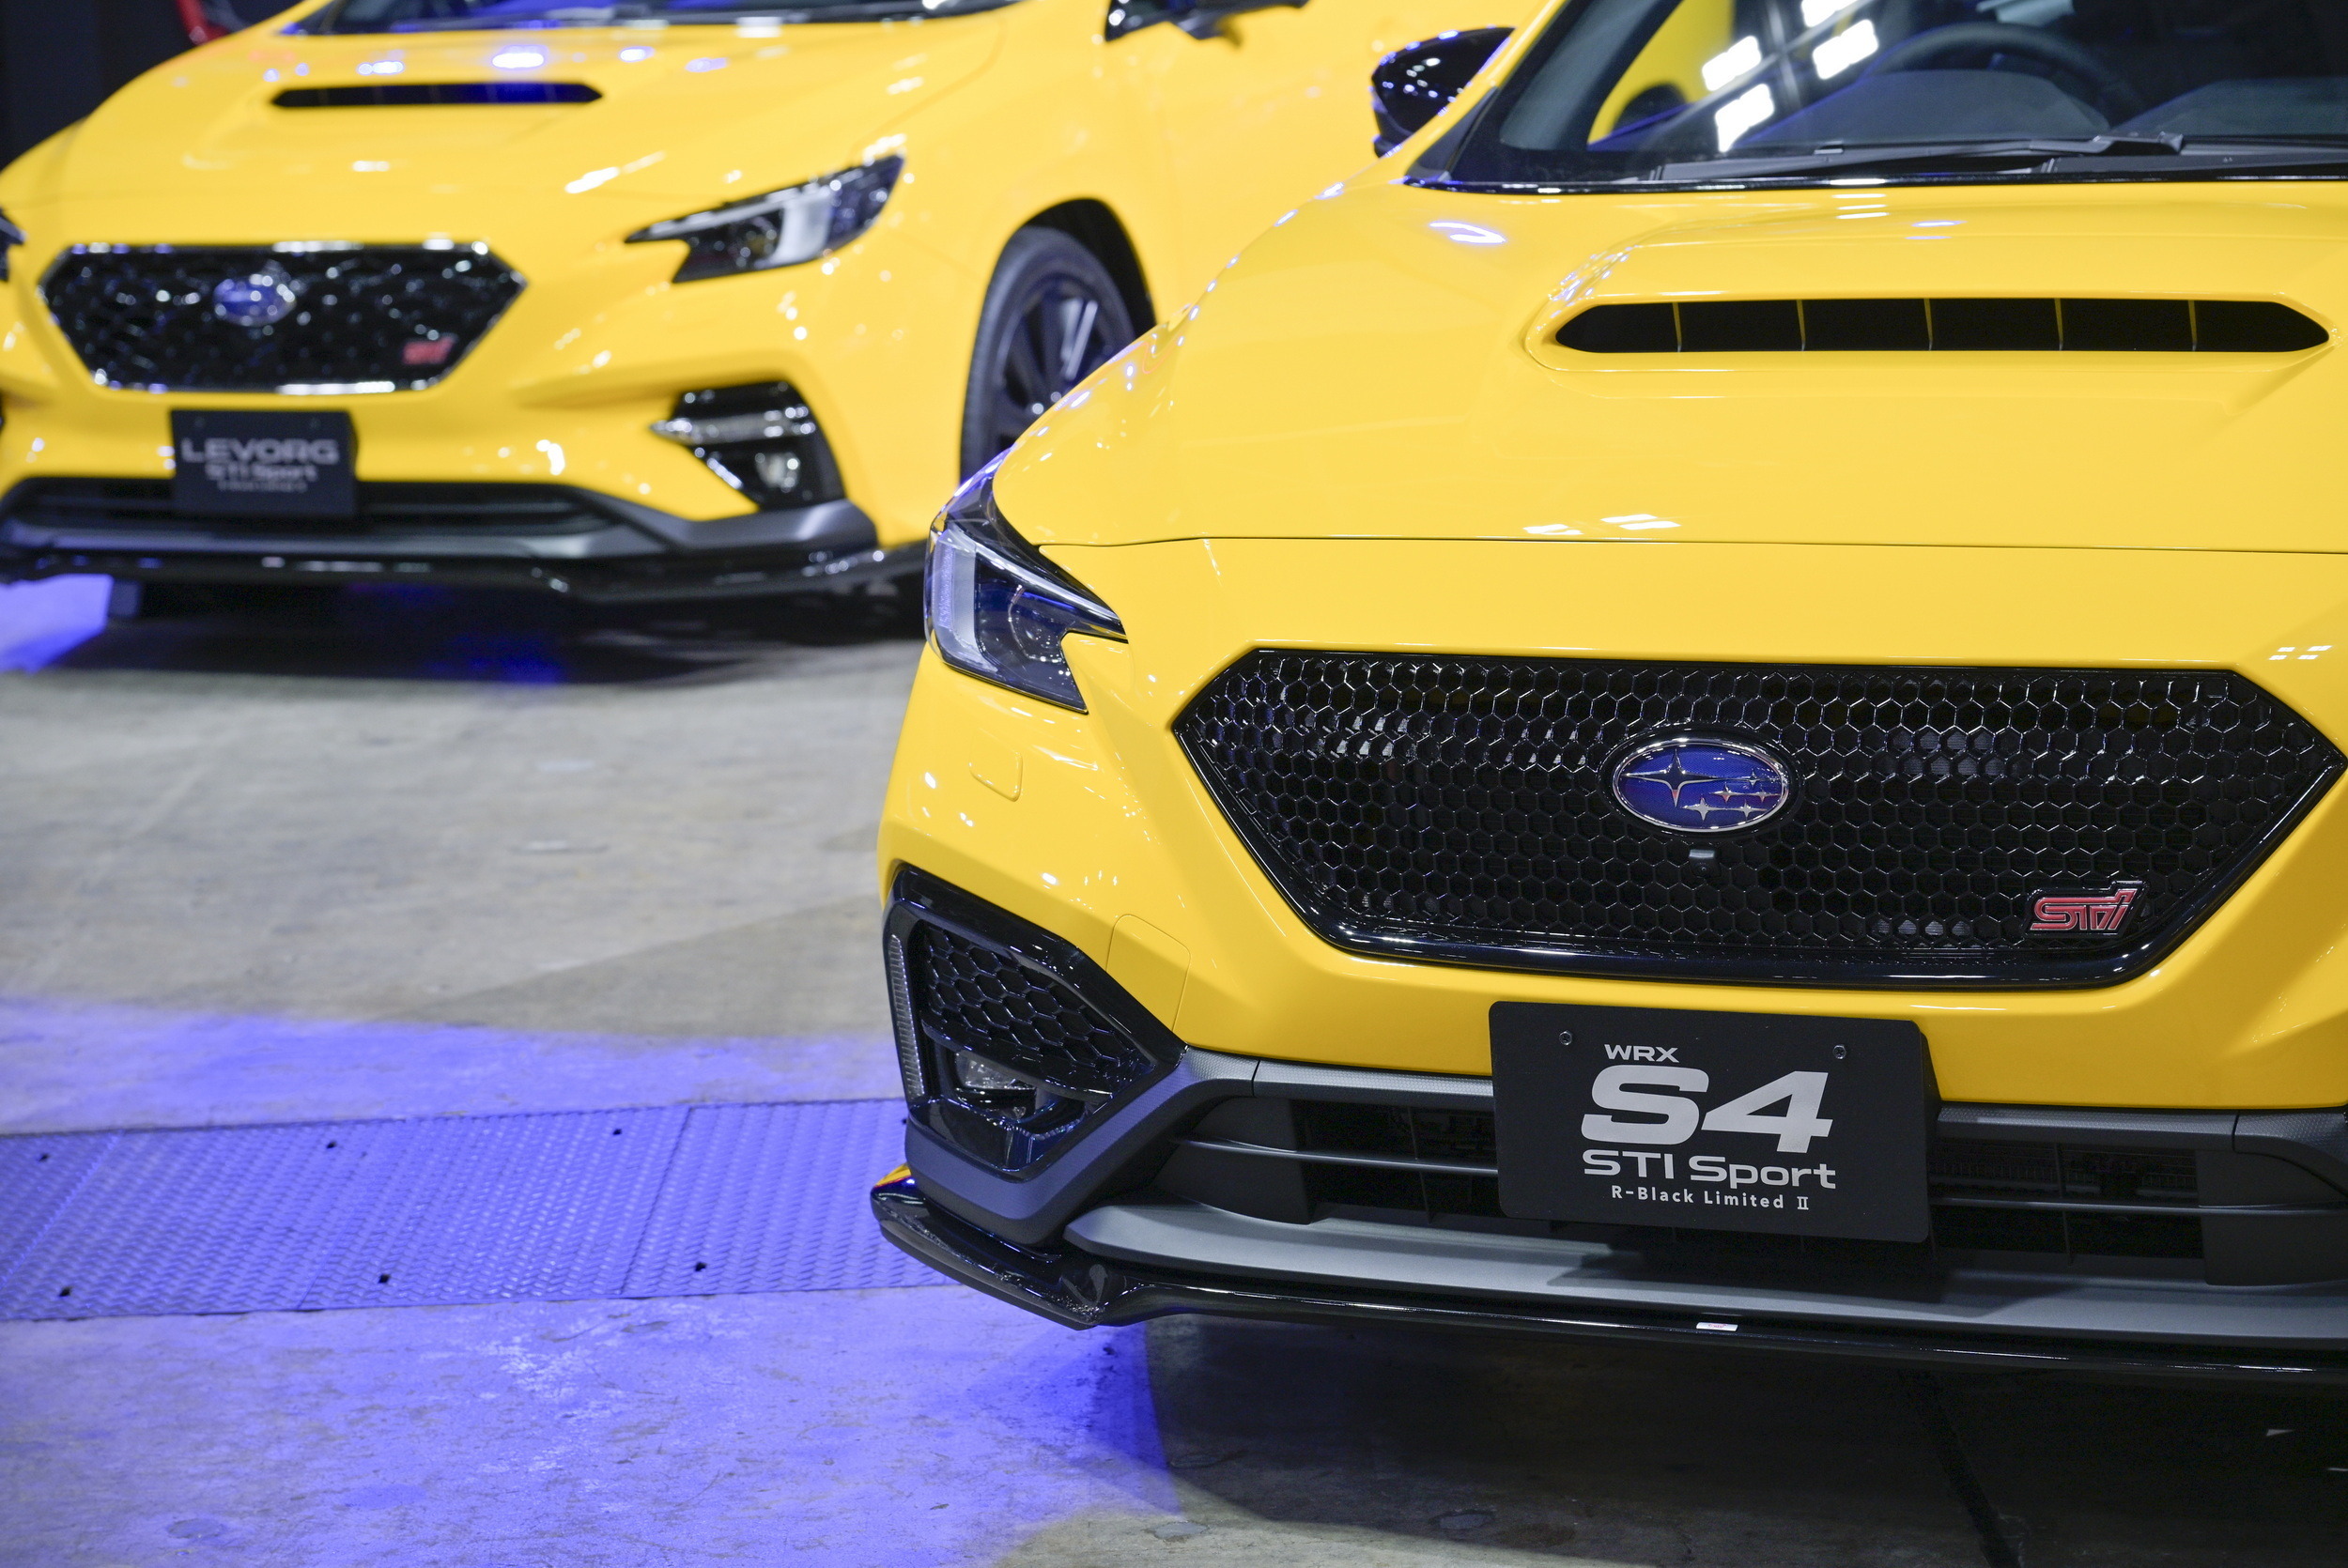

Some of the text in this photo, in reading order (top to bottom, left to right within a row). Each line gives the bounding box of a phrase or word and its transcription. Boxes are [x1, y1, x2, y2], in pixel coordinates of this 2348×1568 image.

[180, 438, 340, 465] LEVORG
[1604, 1043, 1680, 1064] WRX
[1581, 1064, 1834, 1154] S4
[1582, 1148, 1837, 1190] STI Sport
[1611, 1185, 1694, 1204] R-Black
[1703, 1191, 1784, 1209] Limited
